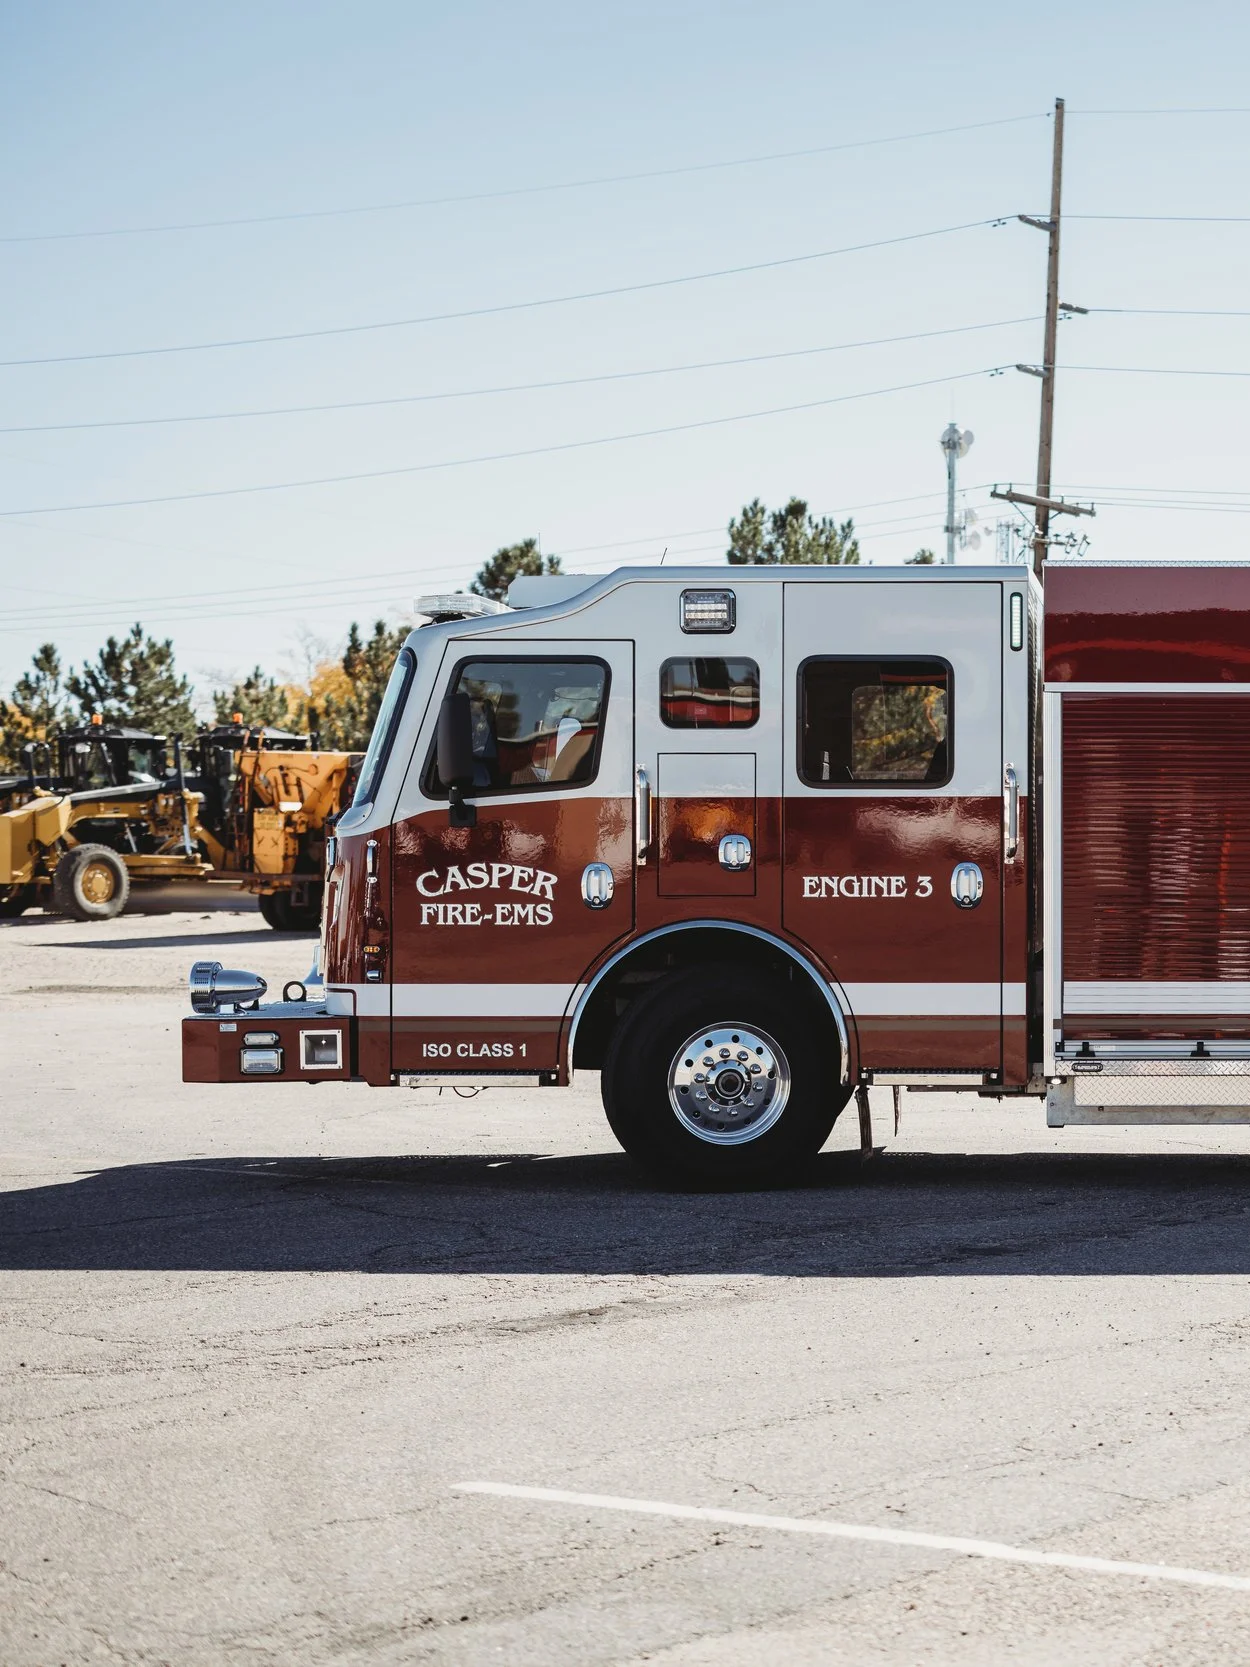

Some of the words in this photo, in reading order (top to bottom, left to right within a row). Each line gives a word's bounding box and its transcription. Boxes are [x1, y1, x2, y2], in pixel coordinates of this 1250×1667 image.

[416, 861, 558, 900] CASPER
[802, 876, 907, 898] ENGINE
[915, 875, 933, 898] 3
[420, 903, 554, 926] FIRE-EMS
[422, 1043, 452, 1058] ISO
[456, 1043, 514, 1058] CLASS
[519, 1043, 527, 1058] 1
